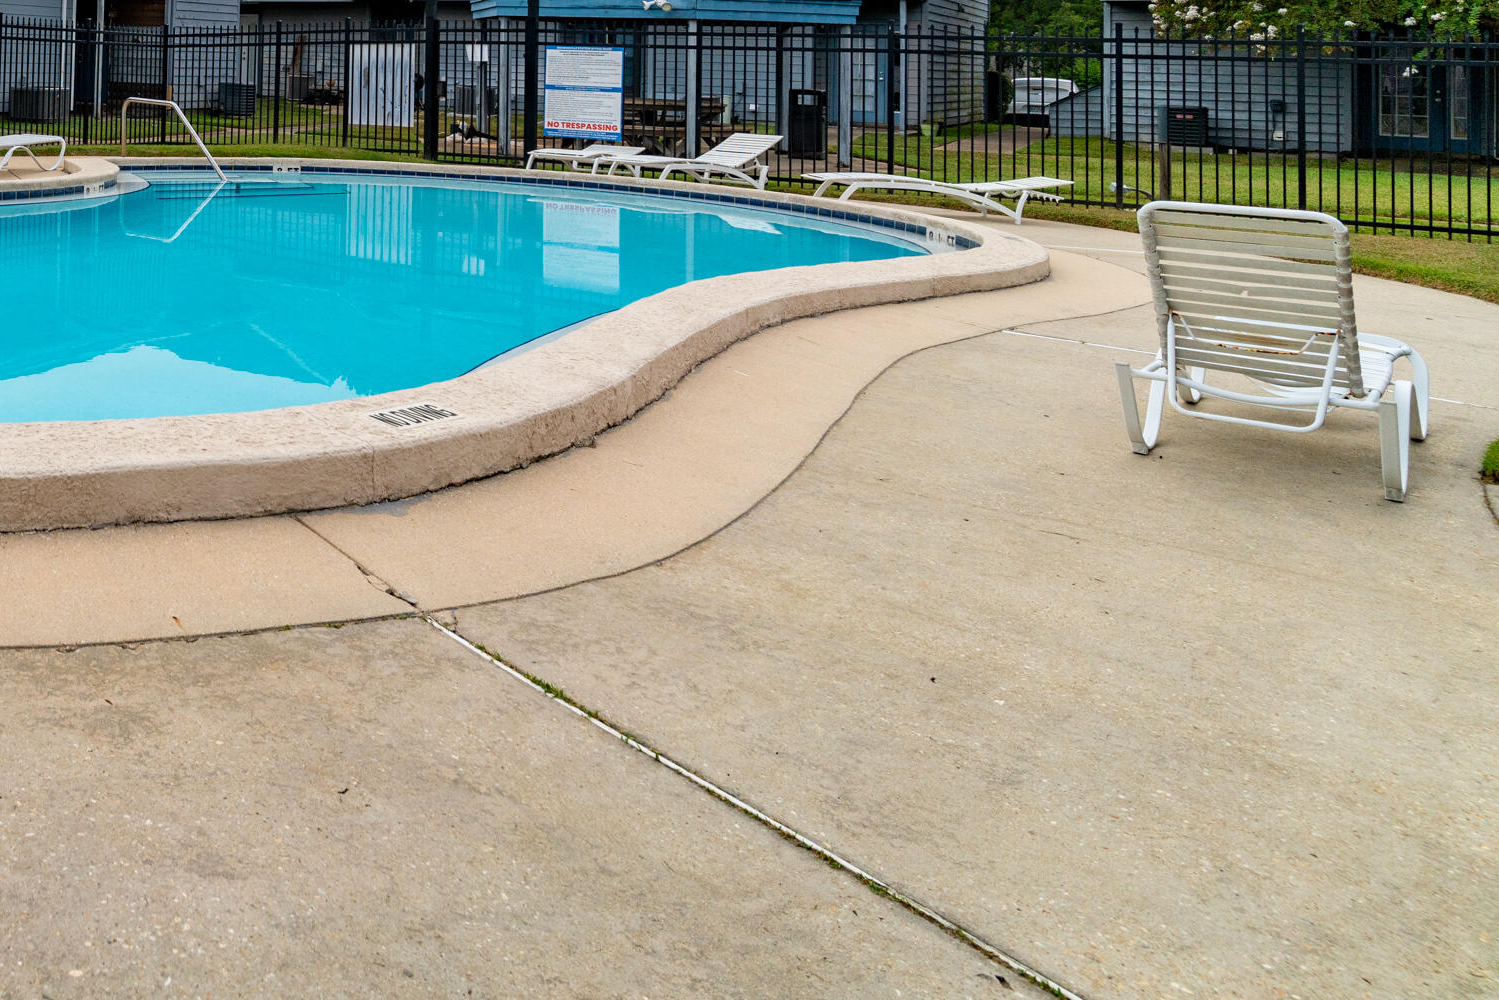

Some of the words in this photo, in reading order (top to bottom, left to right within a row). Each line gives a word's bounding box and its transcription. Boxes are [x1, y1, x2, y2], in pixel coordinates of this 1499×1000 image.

[561, 122, 618, 132] TRESPASSING
[368, 412, 411, 428] NO
[389, 404, 458, 424] DIVING
